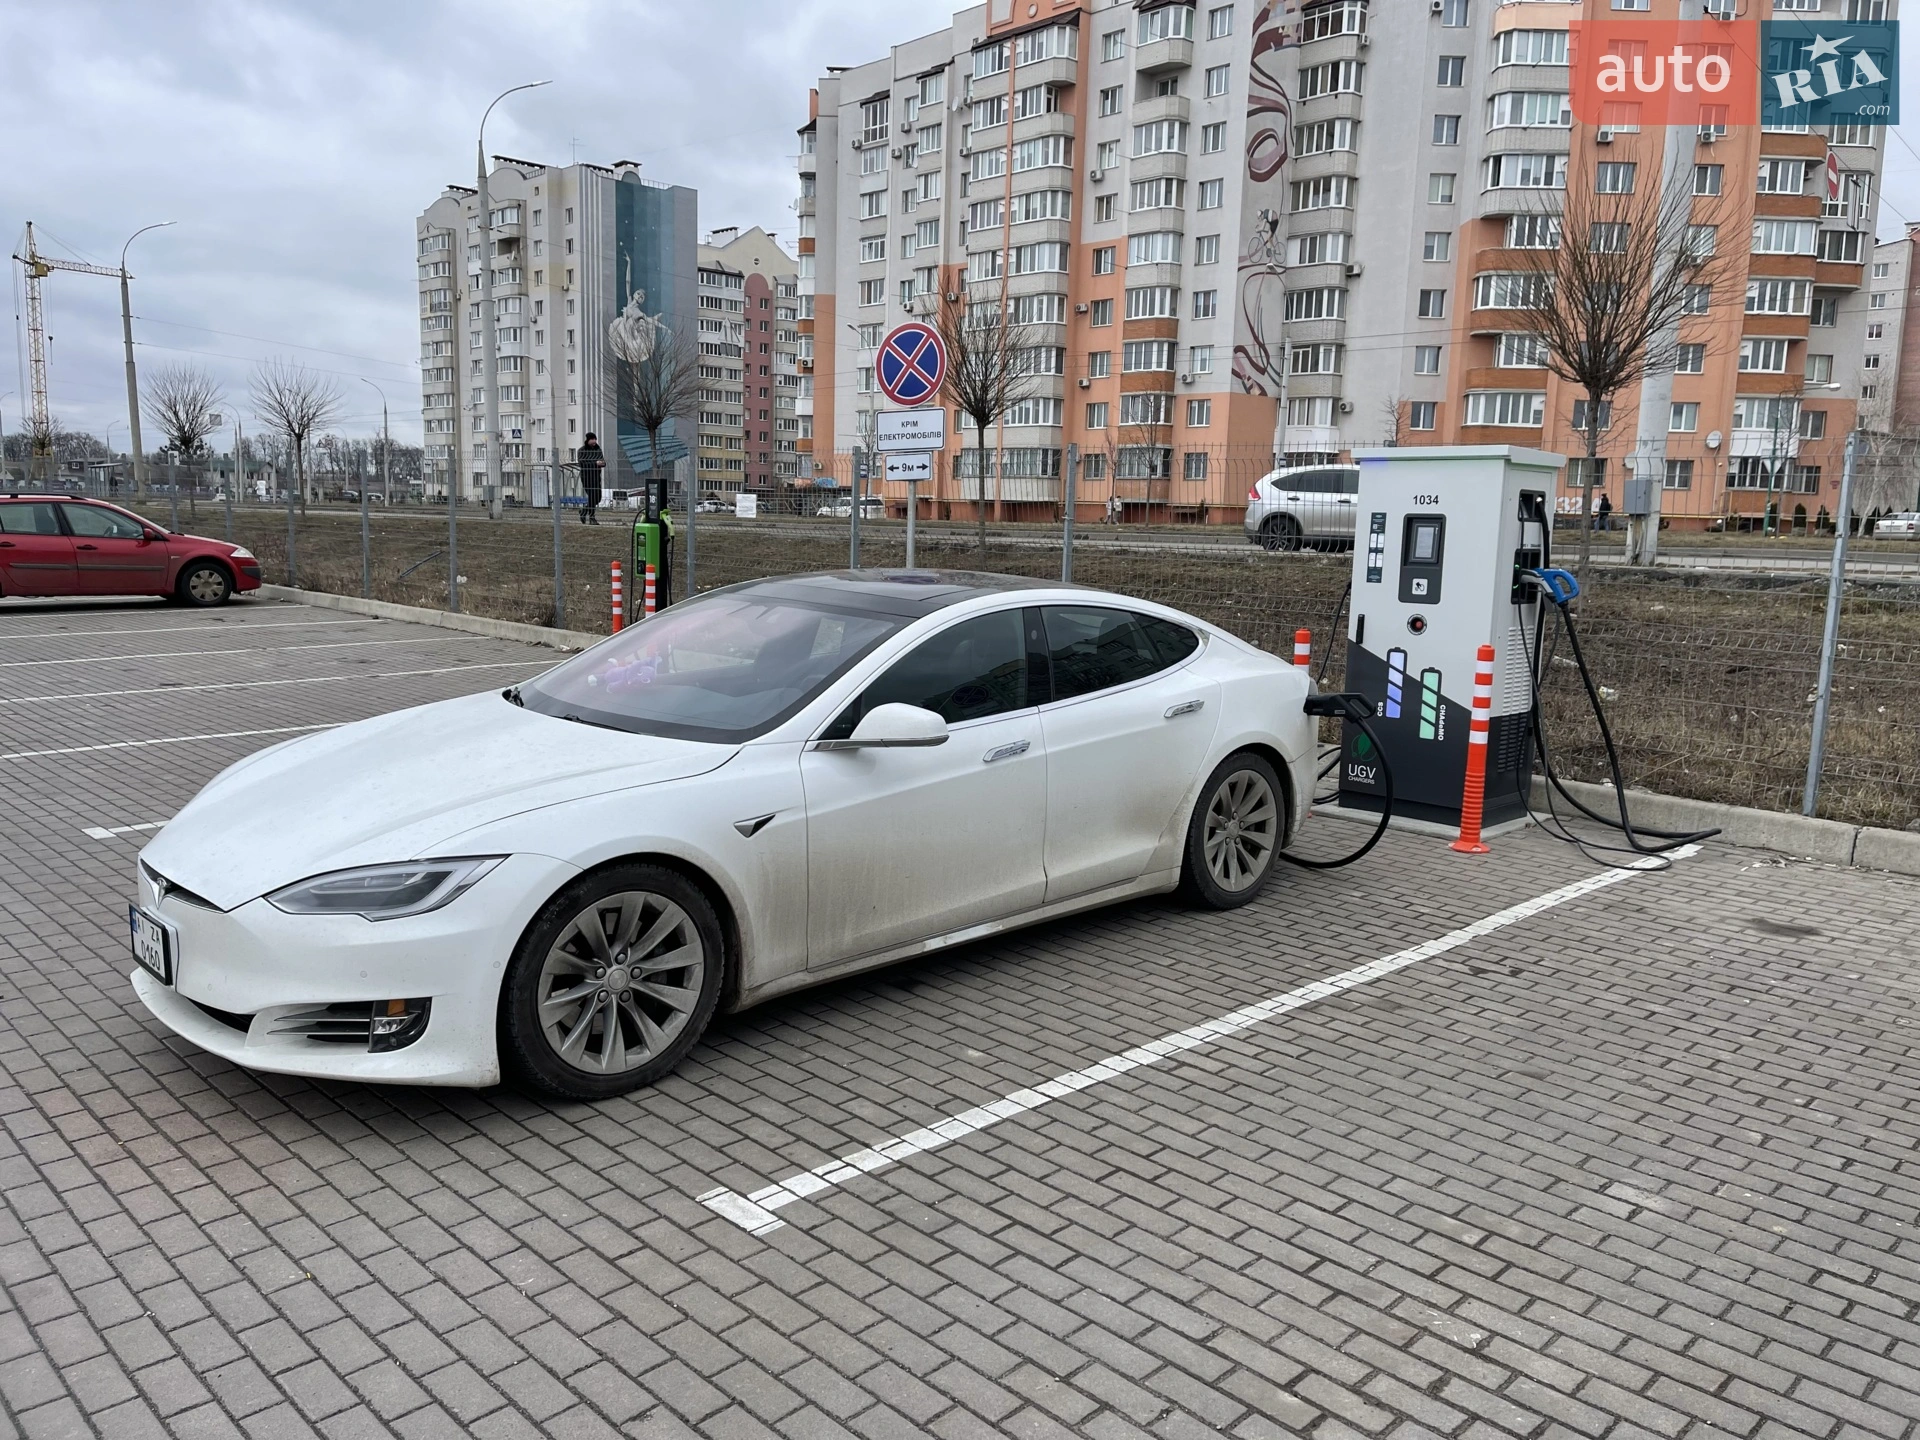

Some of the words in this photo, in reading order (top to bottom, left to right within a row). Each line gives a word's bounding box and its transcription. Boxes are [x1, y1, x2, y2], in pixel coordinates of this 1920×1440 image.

[901, 420, 918, 428] КРІМ
[879, 431, 942, 441] ЕЛЕКТРОМОБІЛІВ
[1412, 494, 1440, 505] 1034
[1437, 704, 1447, 741] CHAdeMO
[1348, 763, 1377, 779] UGV
[1347, 775, 1375, 785] CHARGERS
